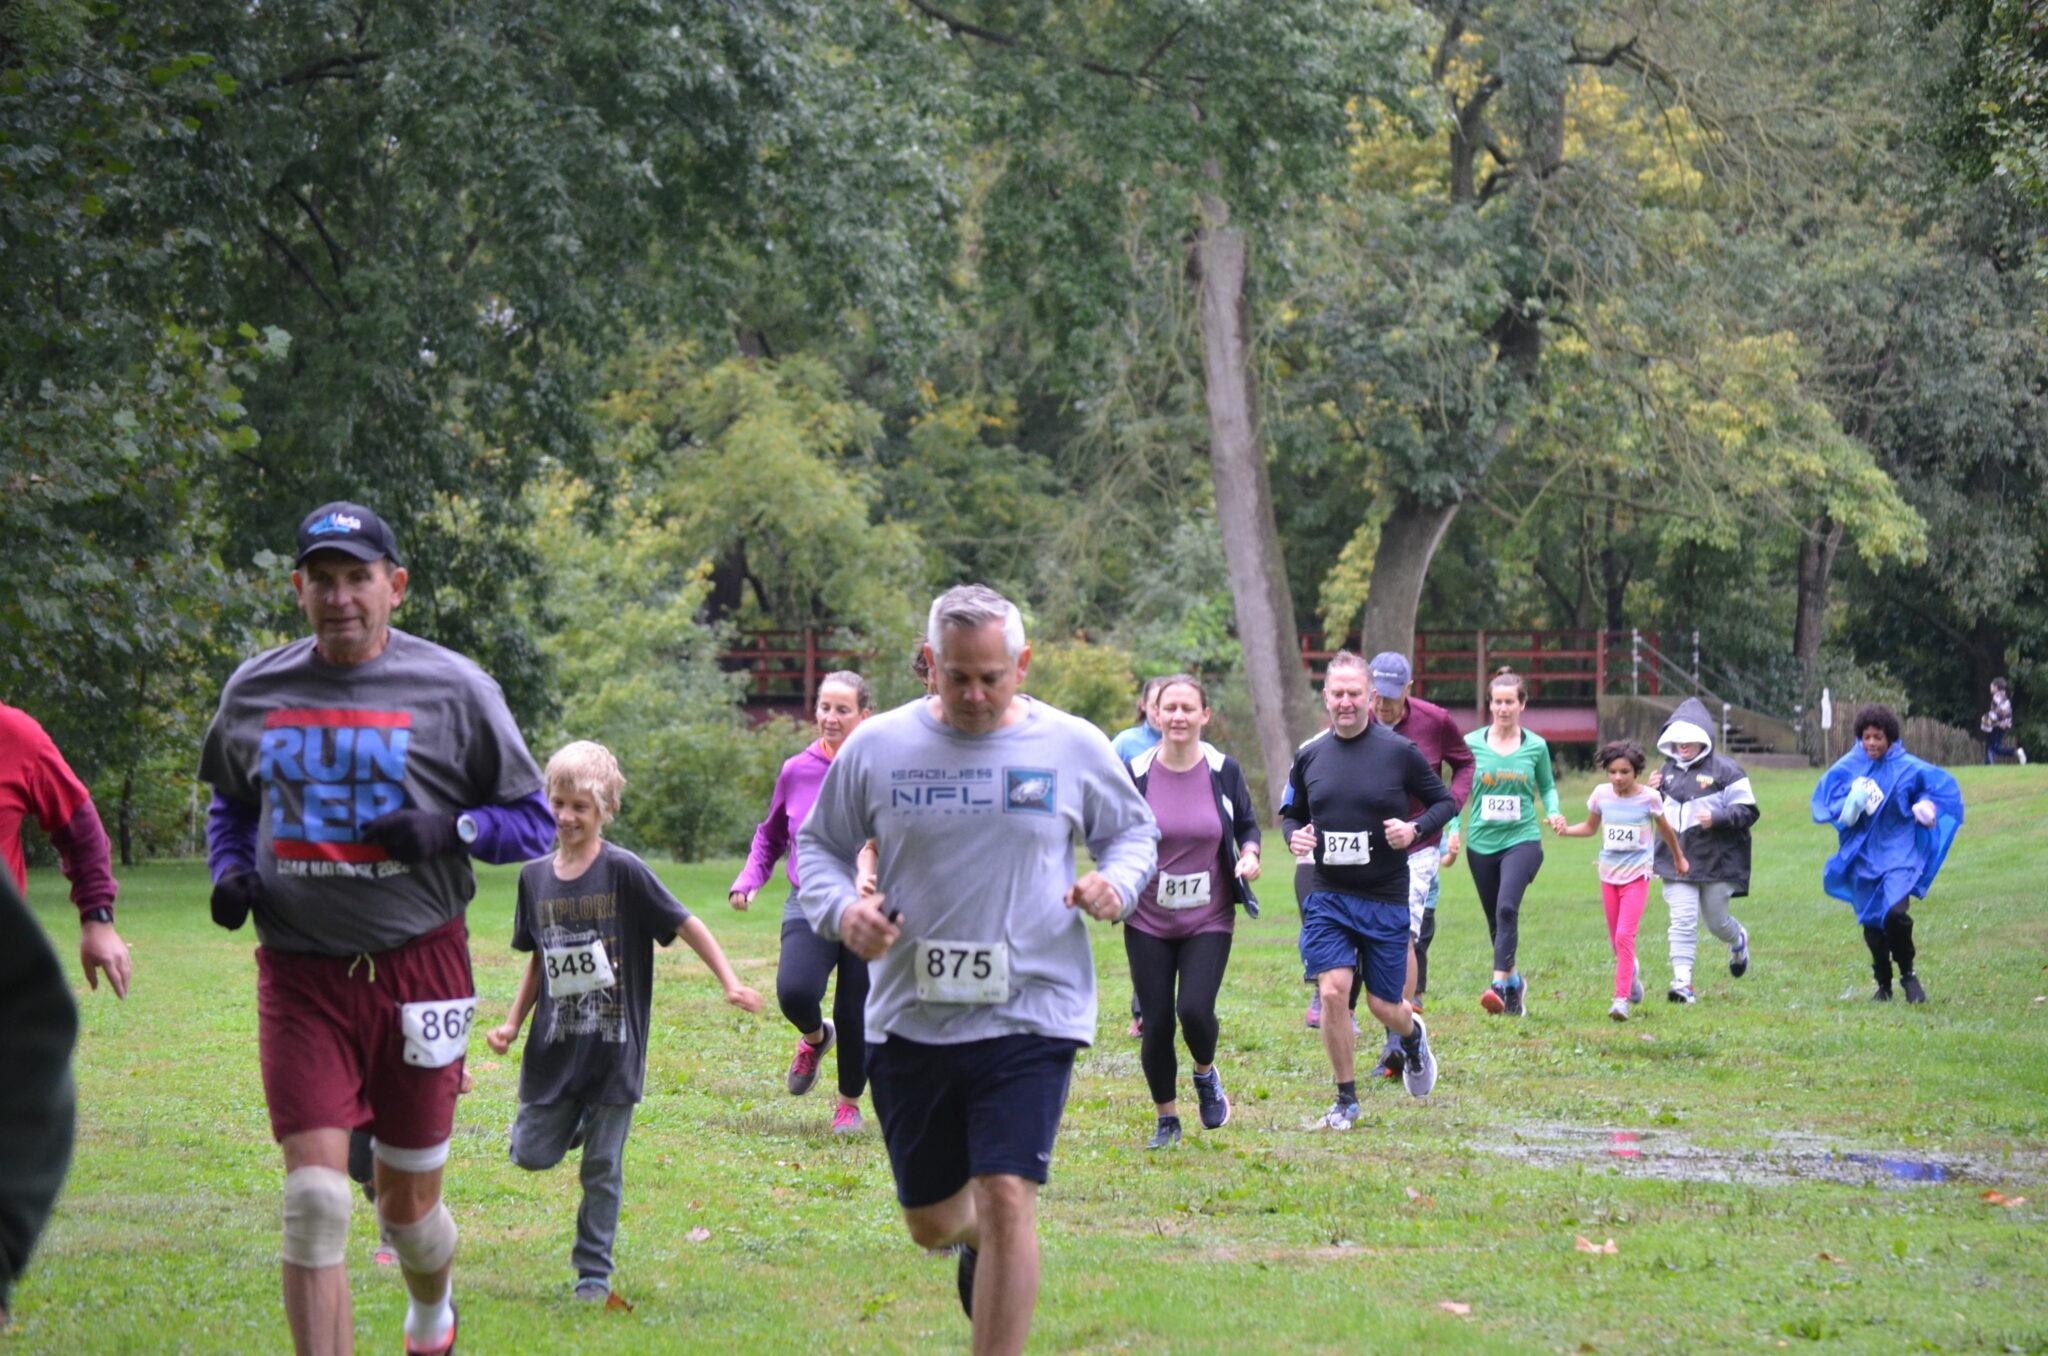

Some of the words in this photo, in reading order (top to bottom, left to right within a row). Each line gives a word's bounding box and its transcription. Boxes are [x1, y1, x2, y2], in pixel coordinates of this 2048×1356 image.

[260, 727, 410, 782] RUN
[891, 768, 992, 780] EAGLES
[892, 787, 992, 806] NFL
[1488, 799, 1514, 811] 823
[1608, 828, 1634, 841] 824
[1328, 836, 1361, 852] 874
[1166, 878, 1201, 896] 817
[547, 952, 595, 979] 848
[927, 948, 991, 979] 875
